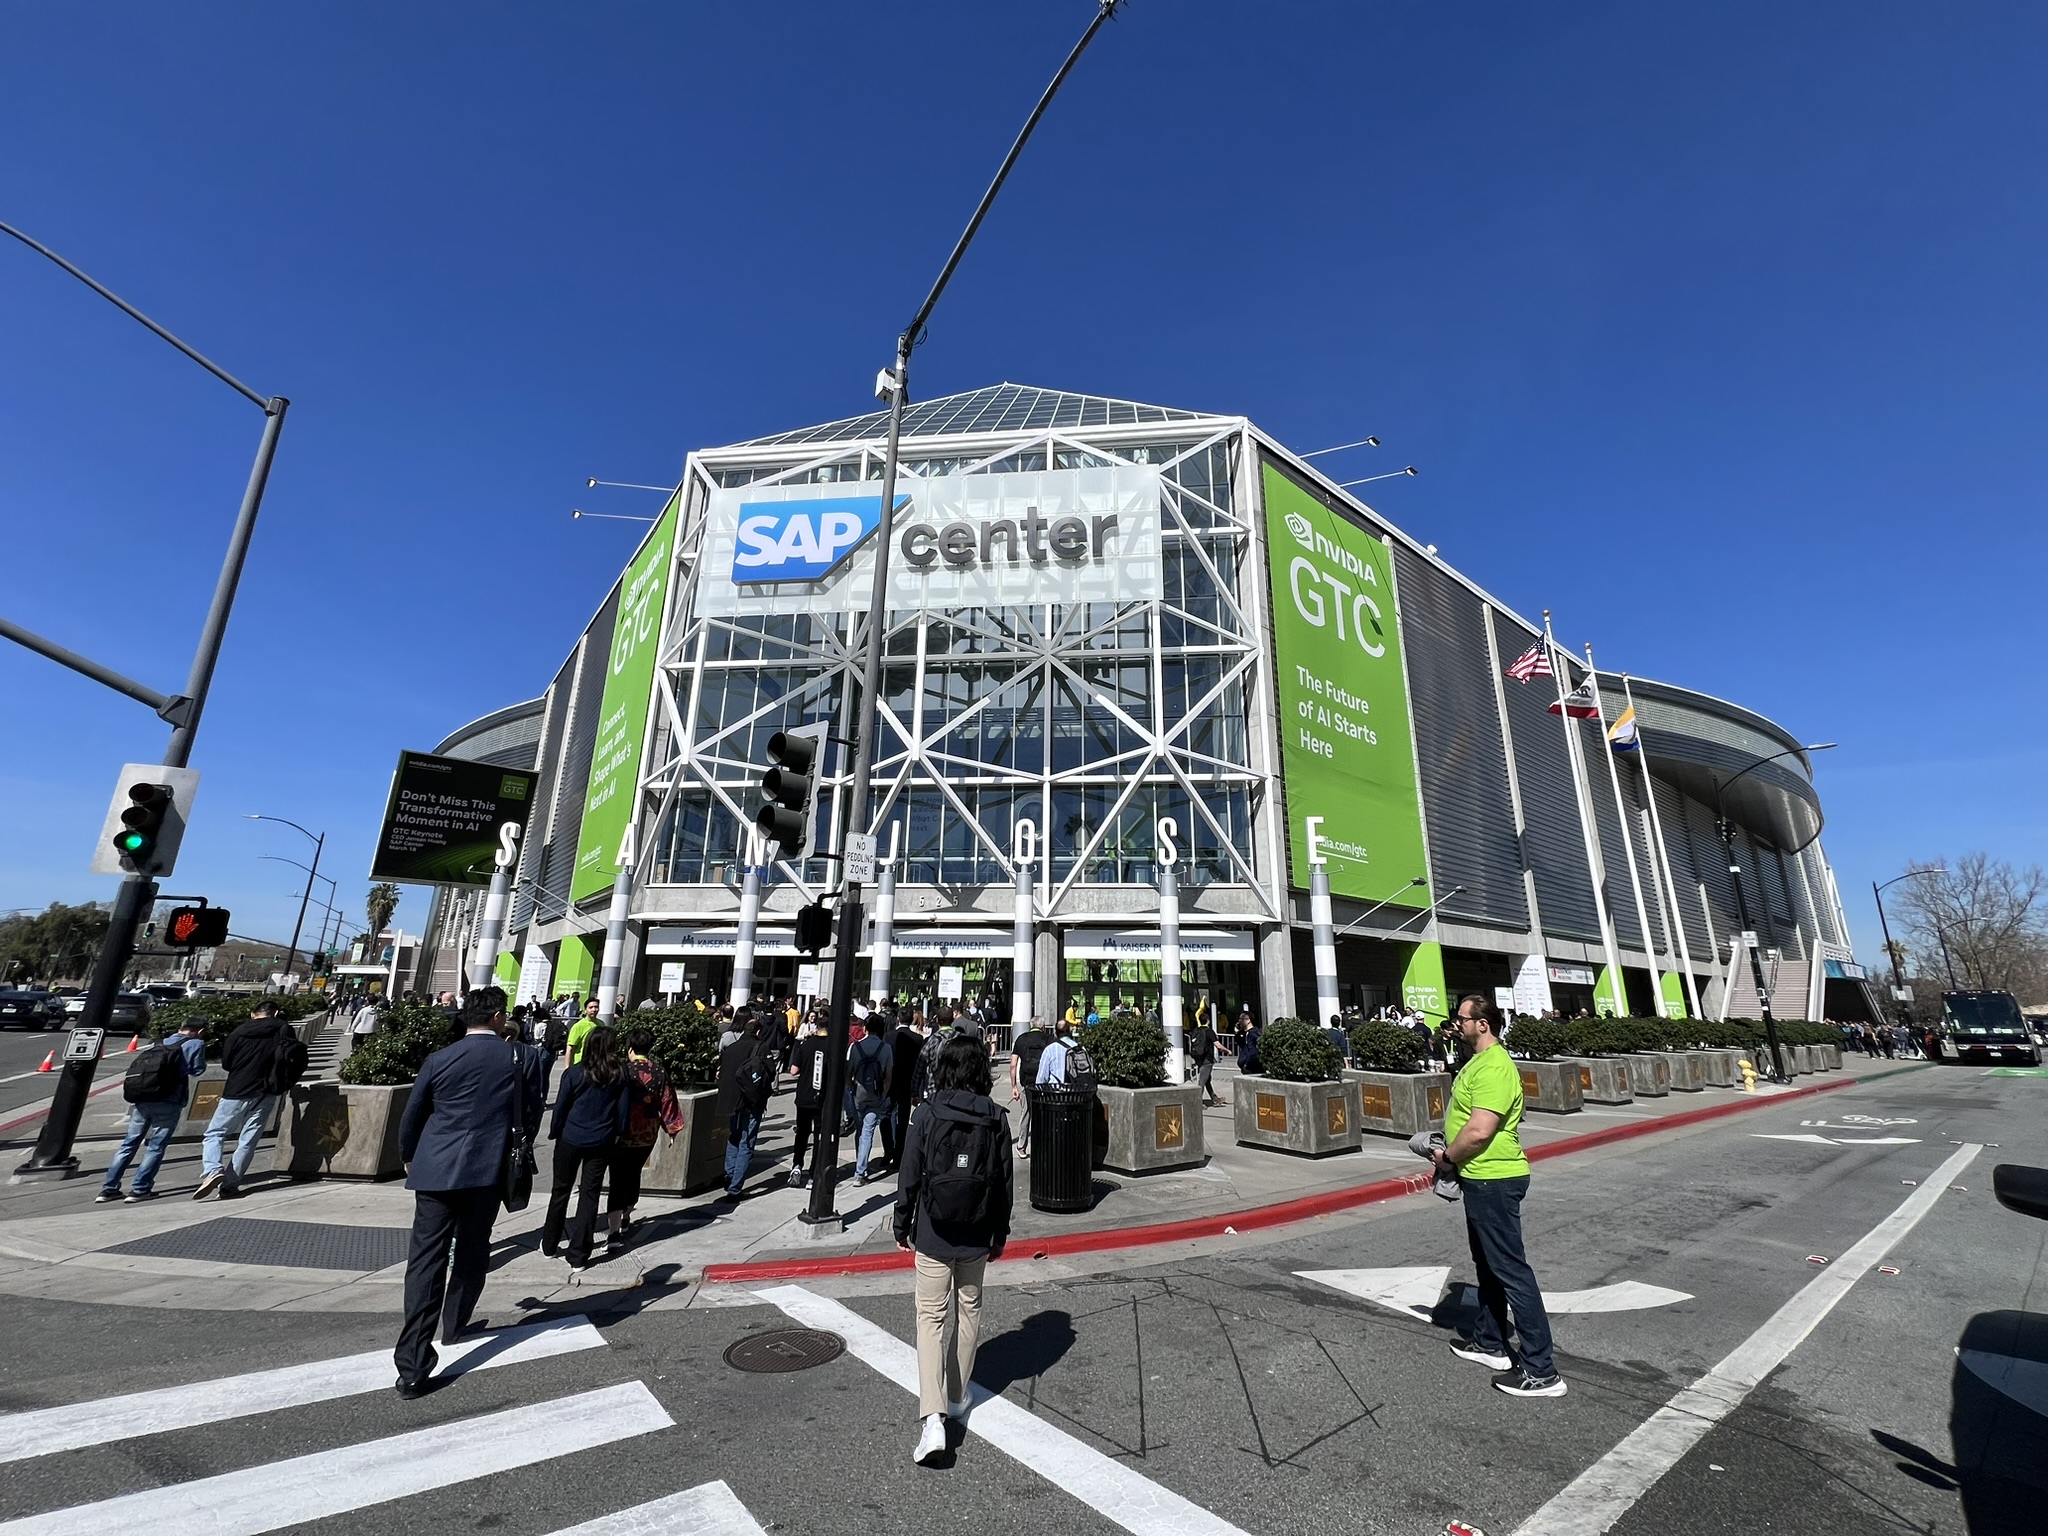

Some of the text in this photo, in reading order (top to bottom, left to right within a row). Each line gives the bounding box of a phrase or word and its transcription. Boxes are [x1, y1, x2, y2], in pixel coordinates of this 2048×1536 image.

[734, 506, 1118, 568] SAP center
[1316, 533, 1377, 588] NVIDIA
[1289, 555, 1386, 659] GTC
[613, 578, 660, 676] GTC
[1296, 664, 1370, 715] The Future
[1298, 700, 1378, 746] of AI Starts
[1299, 728, 1334, 760] Here
[504, 786, 524, 795] GTC
[401, 790, 496, 811] Don't Miss This
[398, 801, 494, 822] Transformative
[396, 812, 480, 832] Moment in AI
[392, 827, 444, 840] GTC Keynote
[856, 842, 866, 850] NO
[847, 852, 874, 864] PEDDLING
[850, 864, 868, 875] ZONE
[698, 940, 780, 949] KAISER PENENTE
[902, 941, 991, 950] KAISER PERMANENTE
[1120, 943, 1214, 952] KAISER PANENTE
[503, 986, 516, 996] TC
[1406, 994, 1440, 1010] GTC
[1598, 1004, 1614, 1015] GT
[1666, 1006, 1682, 1016] TC
